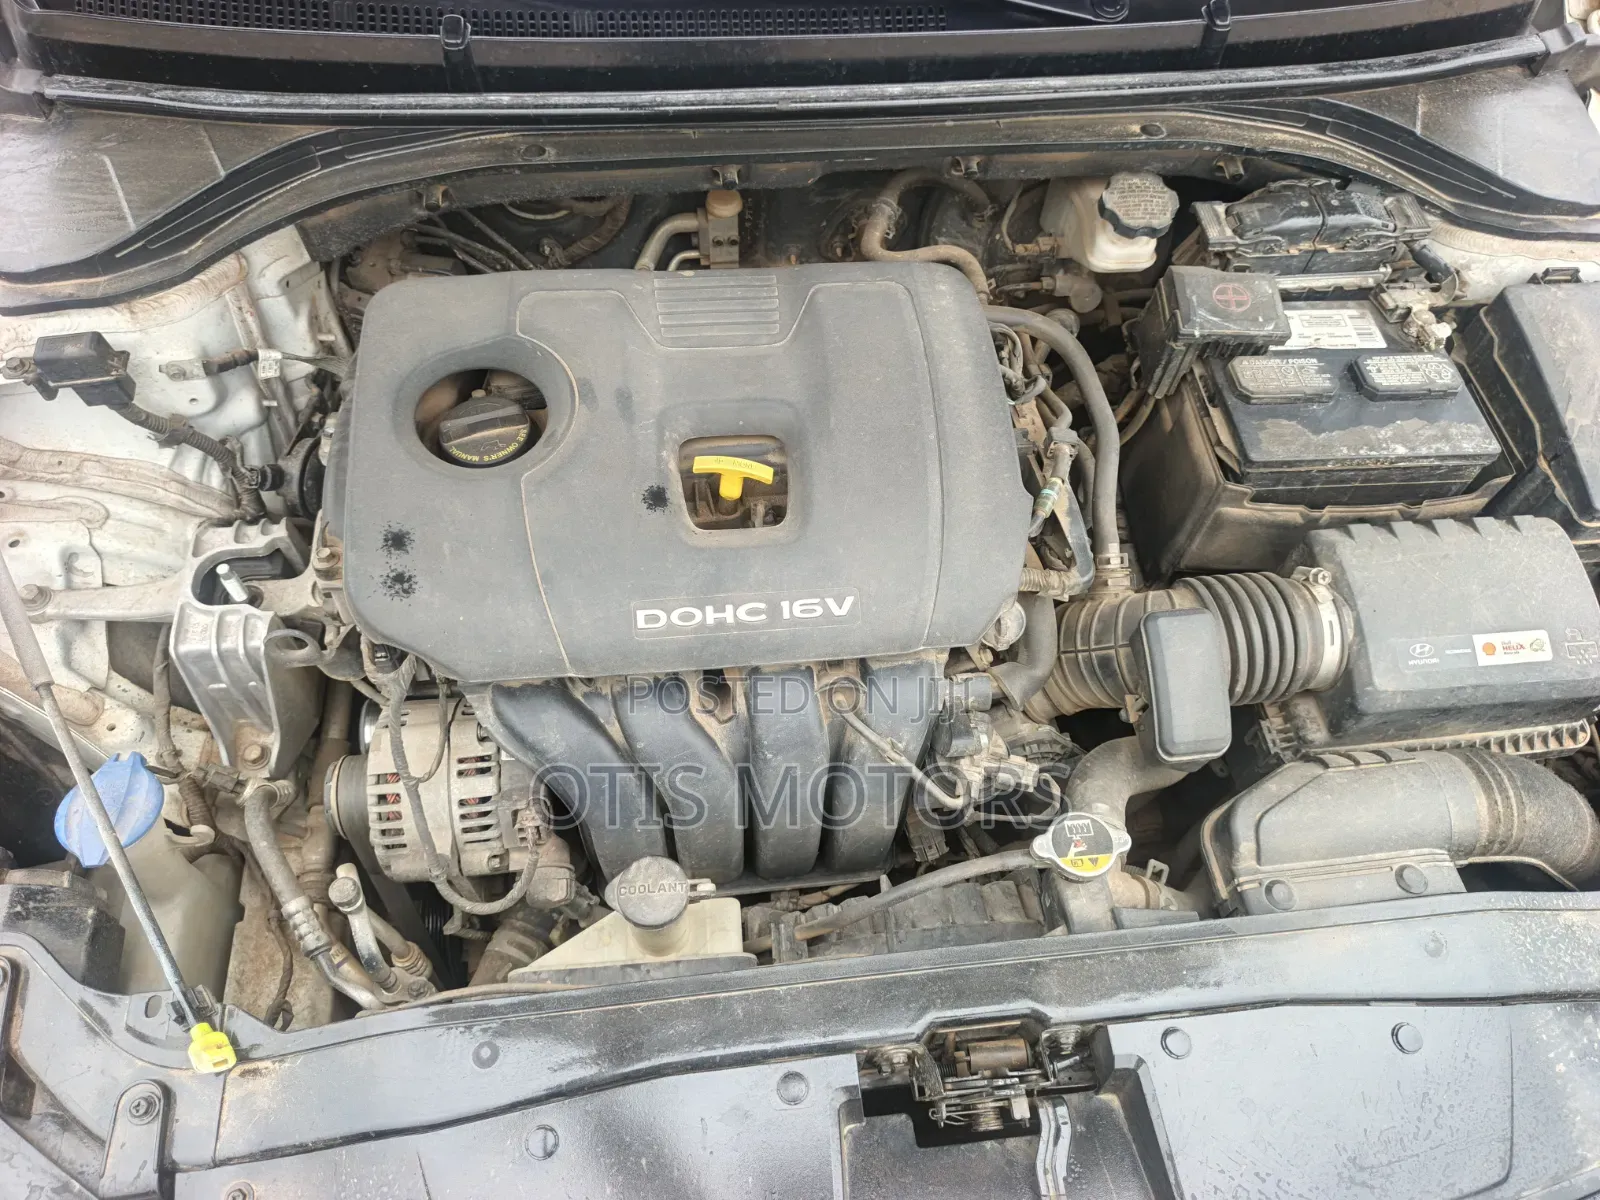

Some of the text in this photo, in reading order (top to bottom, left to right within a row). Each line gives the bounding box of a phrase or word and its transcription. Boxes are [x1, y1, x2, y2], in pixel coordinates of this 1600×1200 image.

[1288, 357, 1318, 365] POISON
[449, 428, 527, 462] SEE OWNER'S MANUAL
[636, 596, 855, 629] DOHC 16V
[1408, 658, 1440, 666] HYUNDAI
[619, 882, 687, 897] COOLANT
